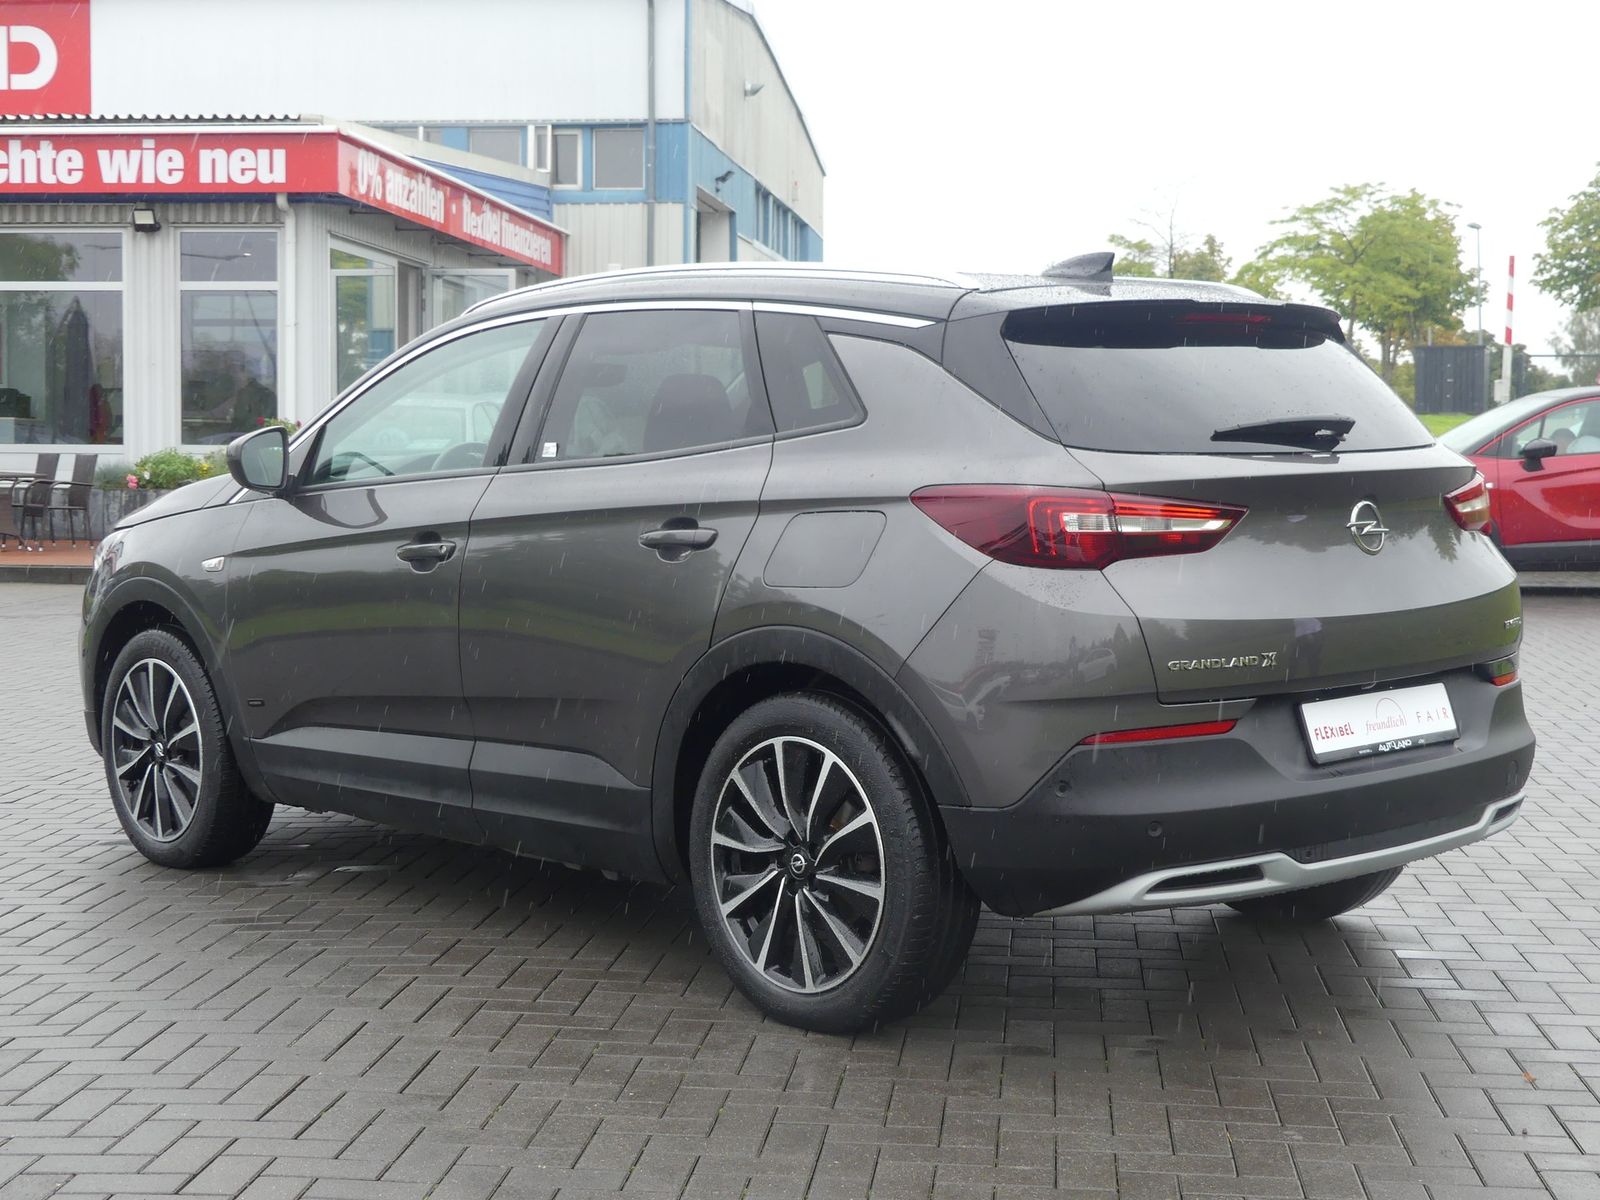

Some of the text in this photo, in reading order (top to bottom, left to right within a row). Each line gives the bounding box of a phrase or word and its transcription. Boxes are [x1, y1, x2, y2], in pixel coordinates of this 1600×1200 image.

[97, 139, 185, 184] wie
[199, 148, 286, 184] neu
[357, 148, 551, 266] 0% anzahlen flexibel finanzieren
[1167, 651, 1278, 671] GRANDLAND X
[1314, 721, 1355, 741] FLEXIBEL
[1378, 739, 1412, 752] AUTOLAND
